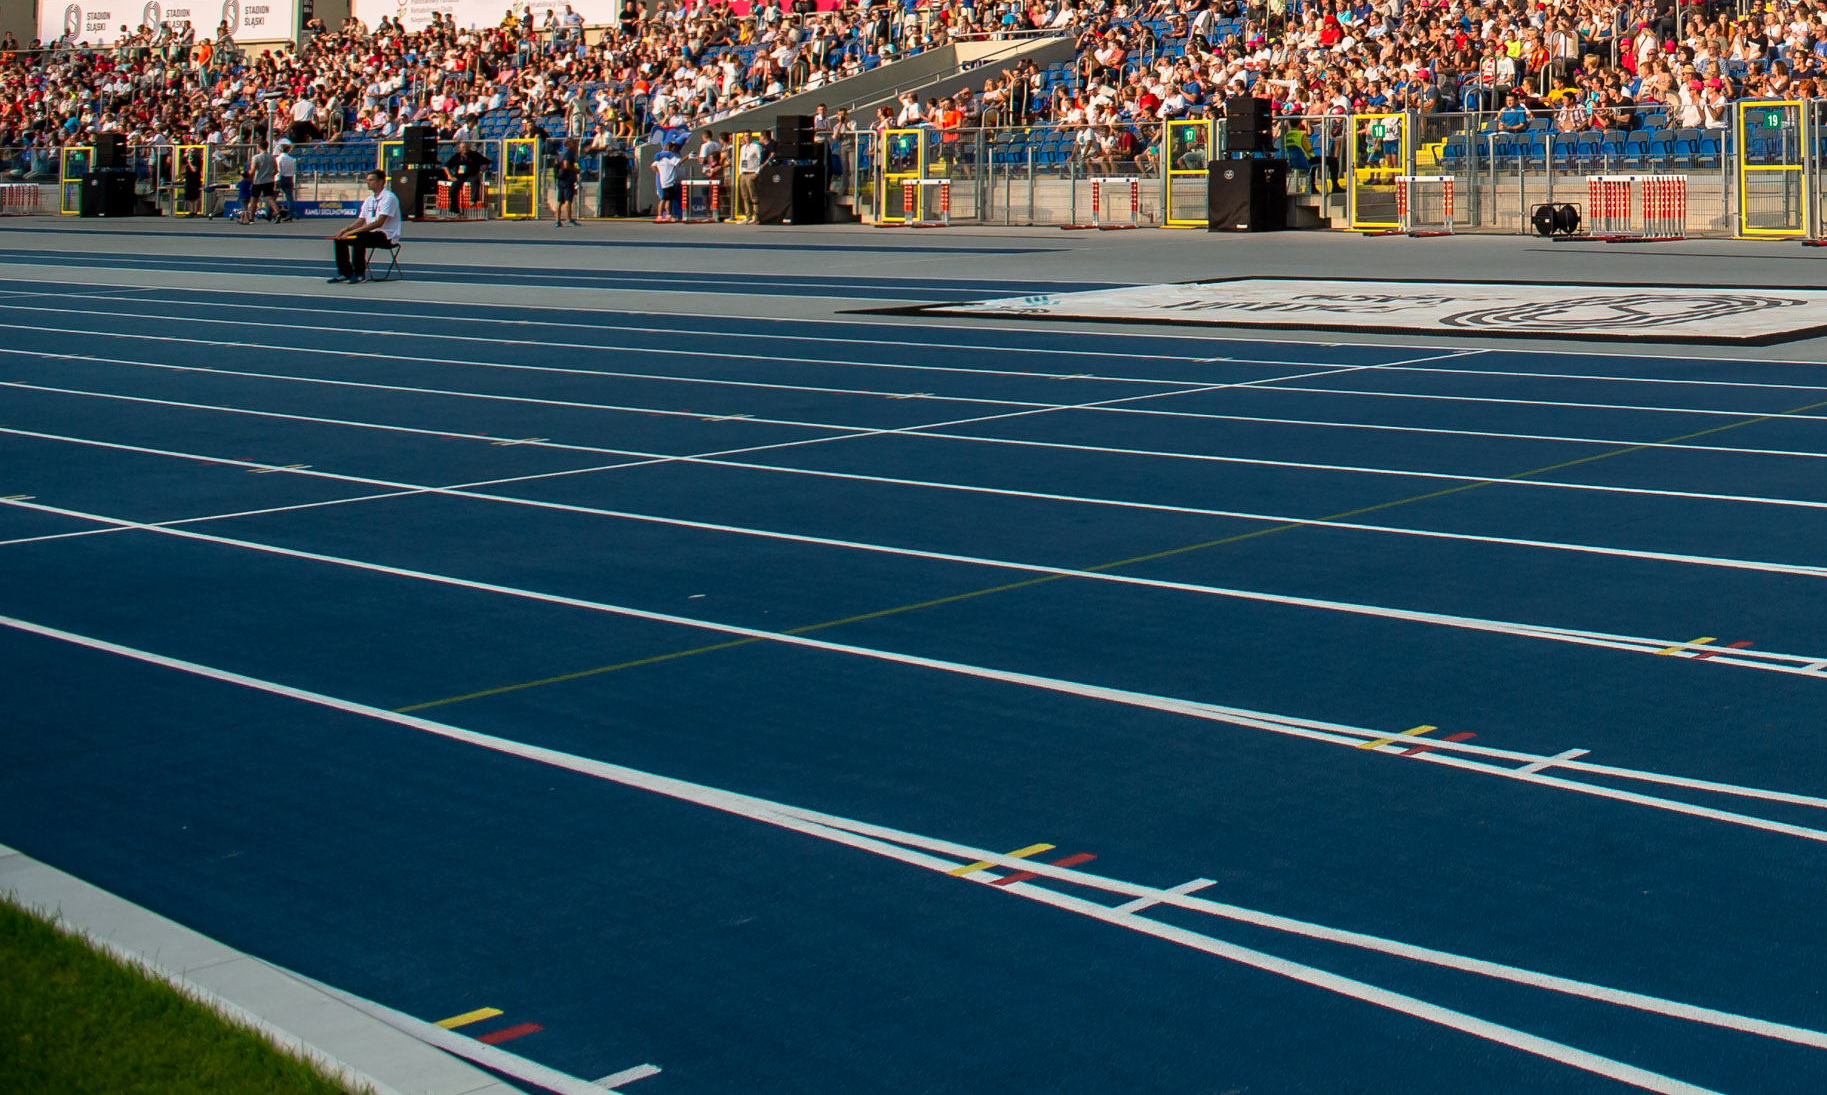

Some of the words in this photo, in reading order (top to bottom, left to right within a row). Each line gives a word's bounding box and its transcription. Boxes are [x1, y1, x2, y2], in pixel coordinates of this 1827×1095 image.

[166, 9, 190, 18] STADION
[244, 5, 270, 15] STADION
[86, 11, 111, 21] STADION
[244, 15, 265, 28] ŚLĄSKI
[86, 21, 106, 34] ŚLĄSKI
[1768, 114, 1778, 127] 19
[1186, 130, 1194, 141] 17
[1374, 126, 1383, 137] 18
